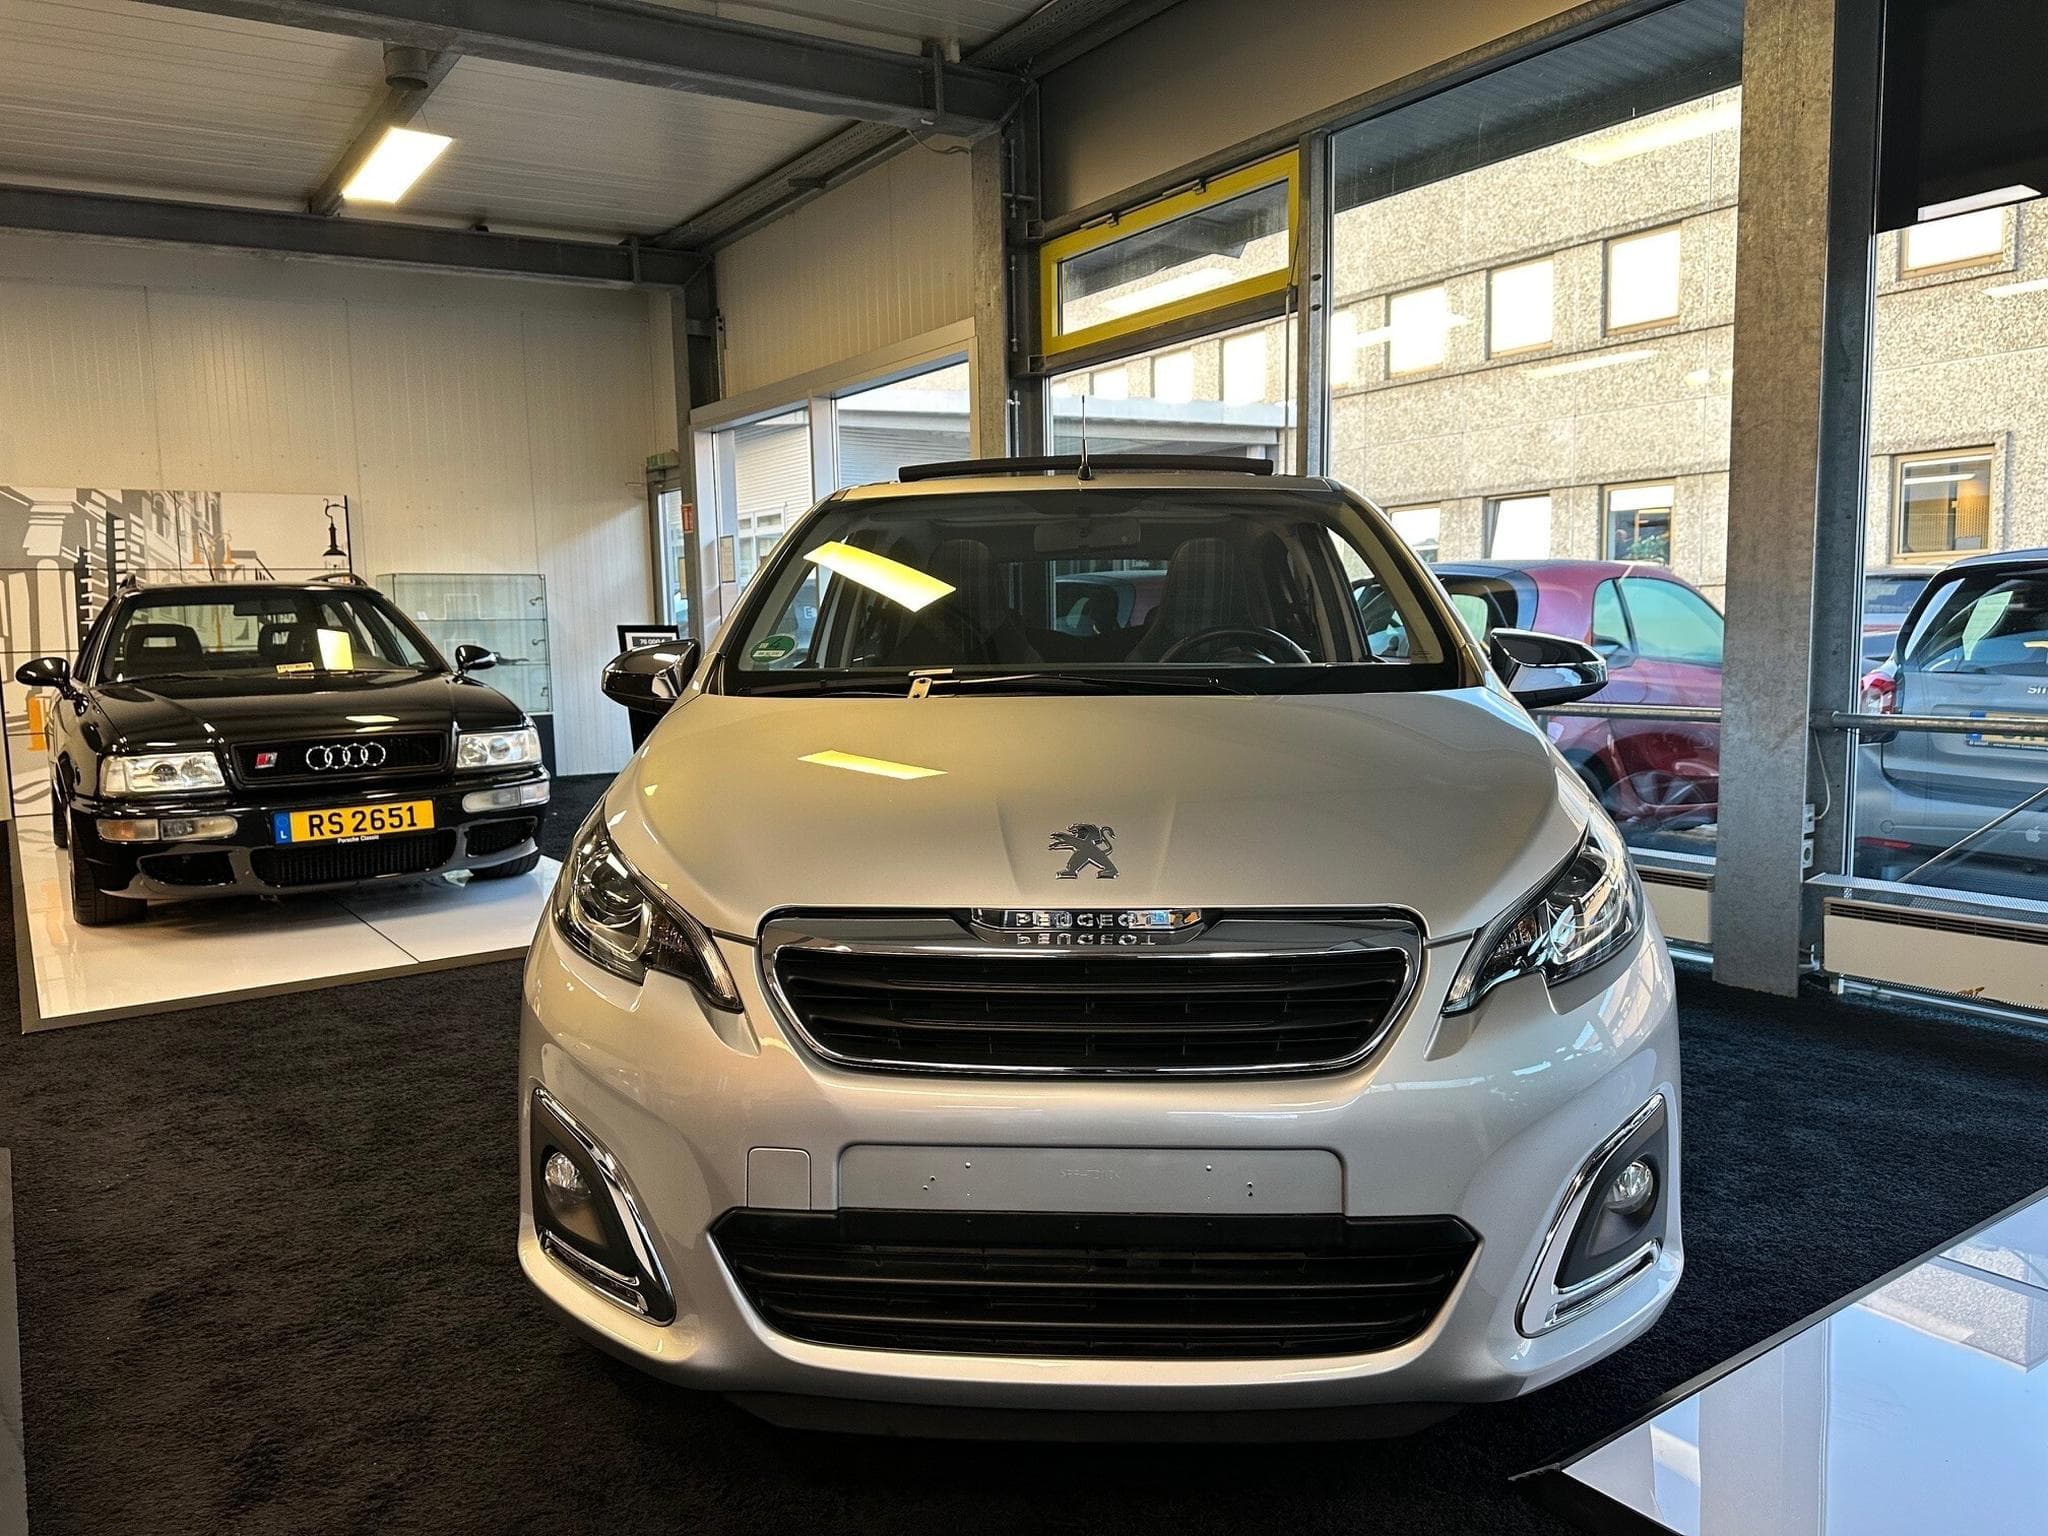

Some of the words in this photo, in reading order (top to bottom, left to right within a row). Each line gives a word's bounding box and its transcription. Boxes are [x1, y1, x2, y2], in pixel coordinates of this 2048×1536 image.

[308, 812, 344, 837] RS
[351, 805, 417, 833] 2651
[280, 830, 288, 839] L
